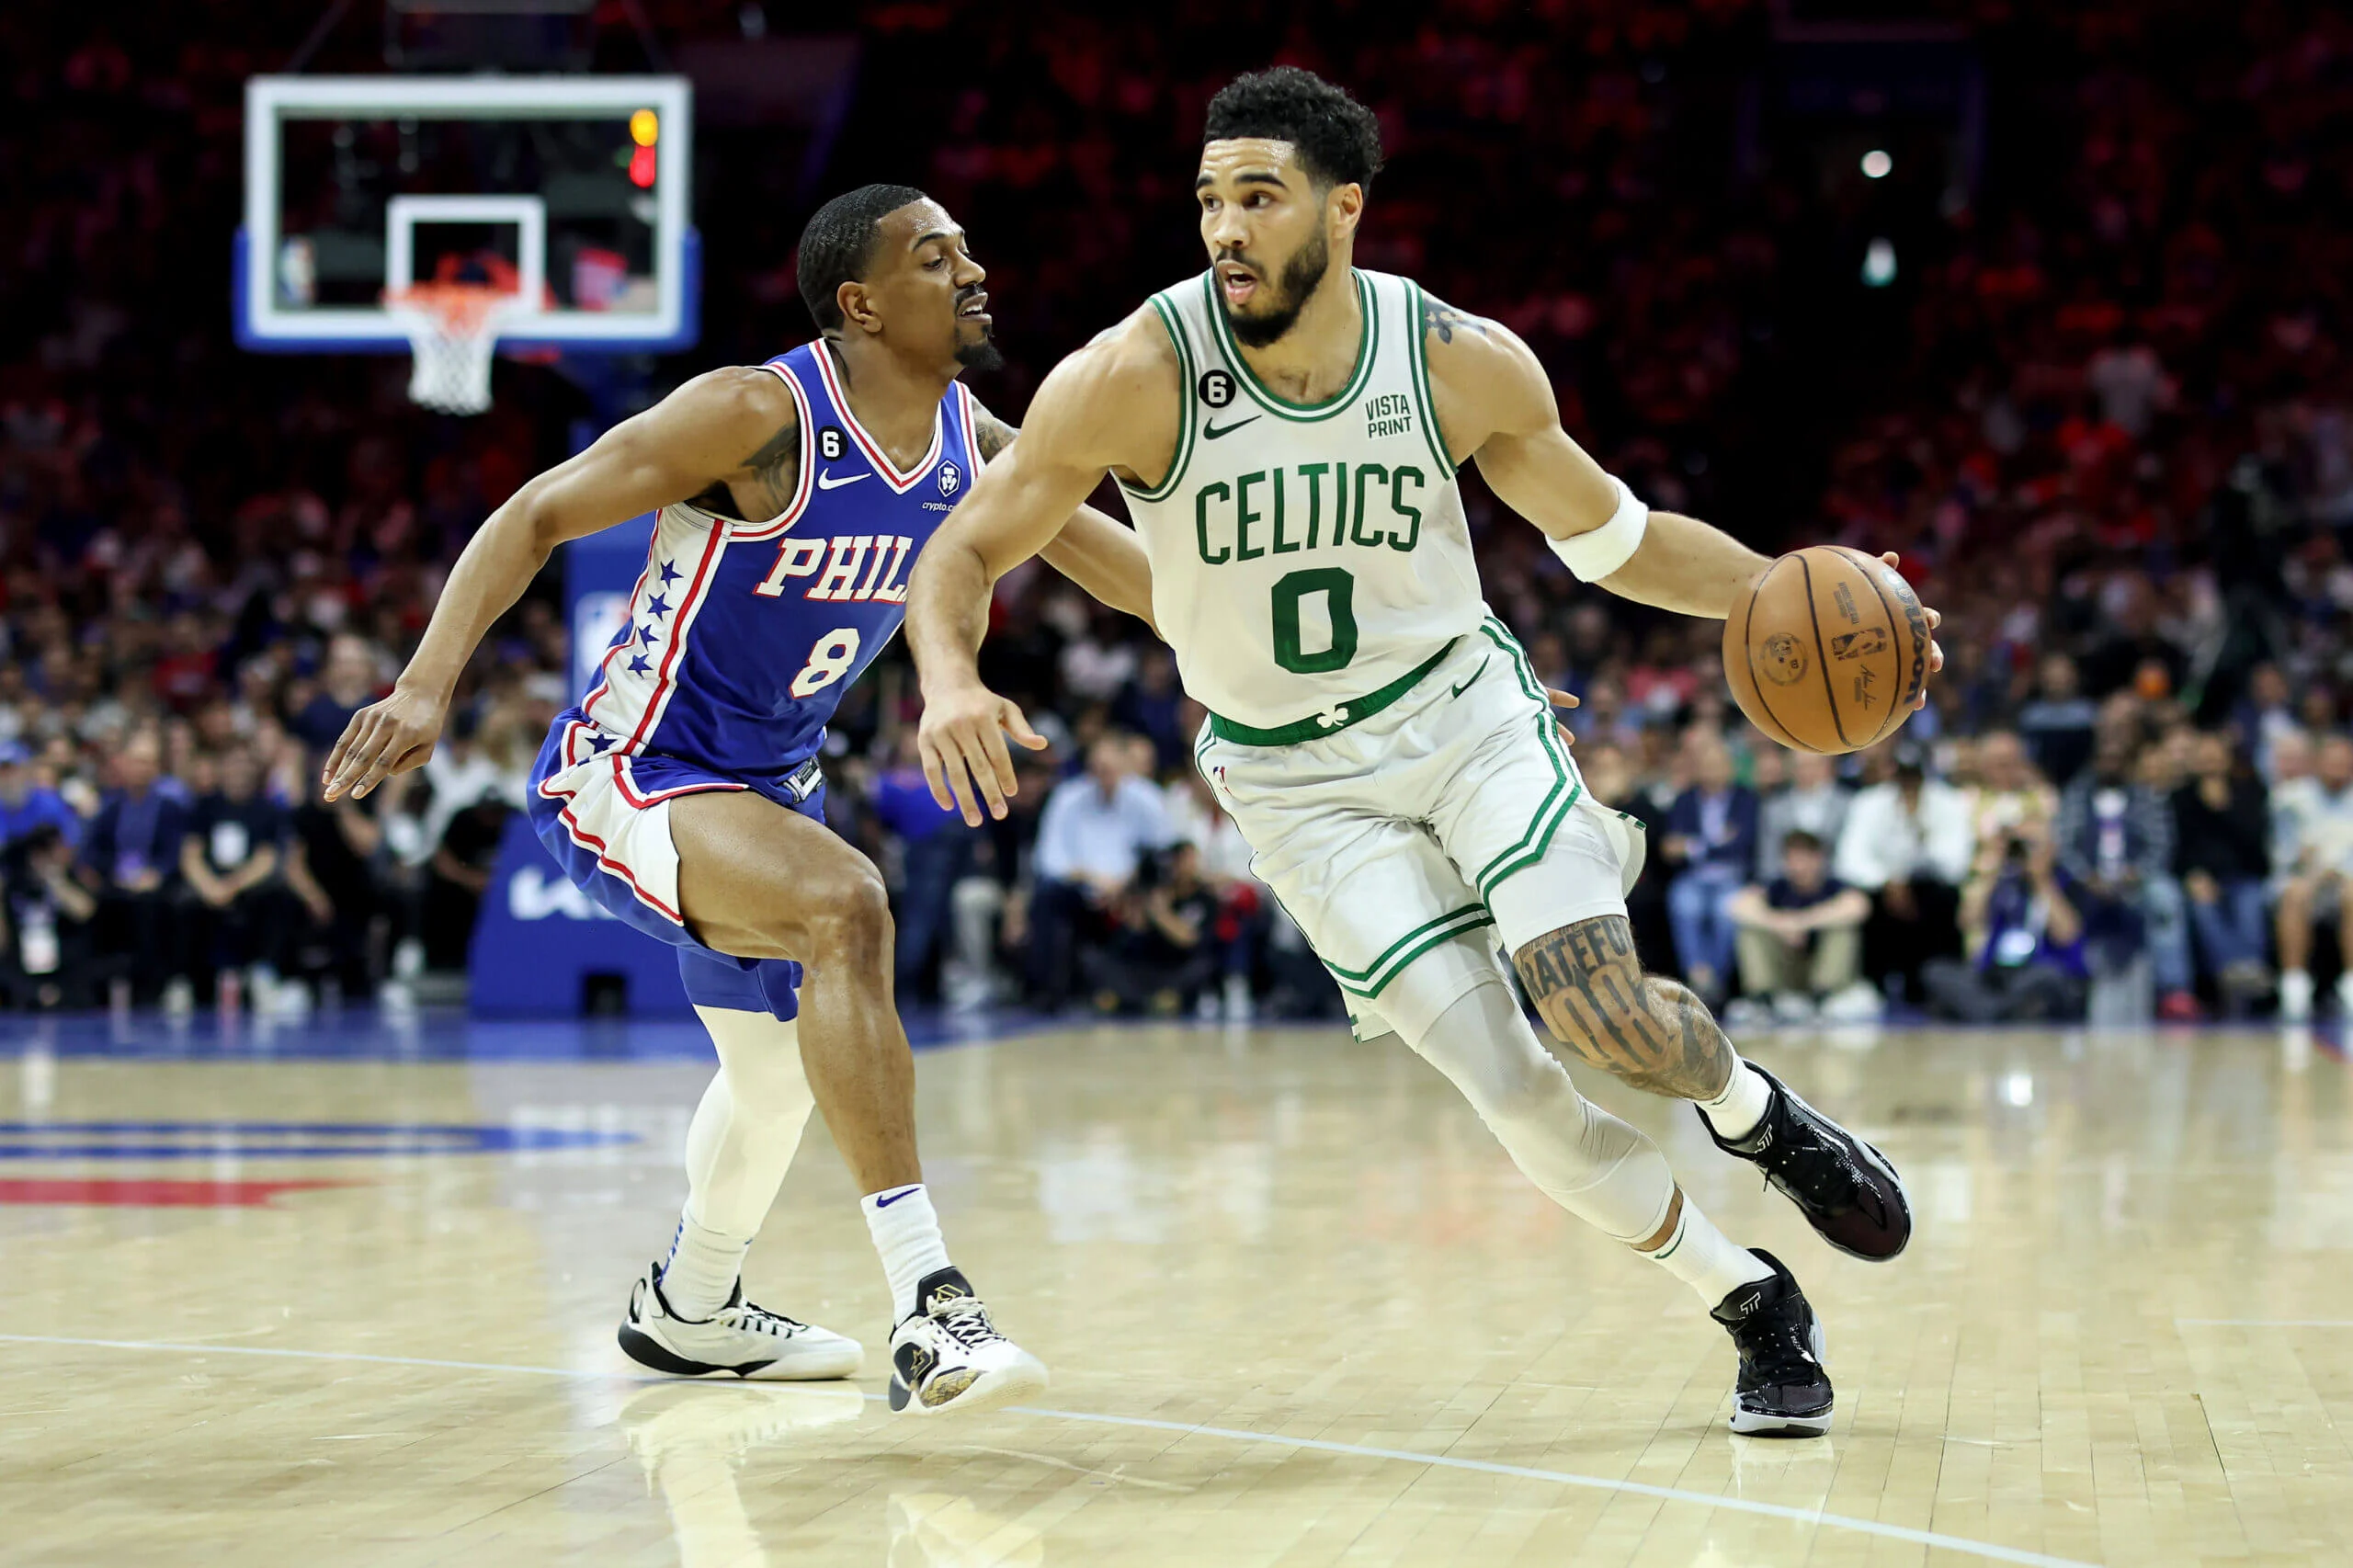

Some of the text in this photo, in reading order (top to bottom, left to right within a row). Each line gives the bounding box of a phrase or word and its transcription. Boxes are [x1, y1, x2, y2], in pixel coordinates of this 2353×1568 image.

[1207, 376, 1227, 404] 6
[1365, 394, 1411, 421] VISTA
[823, 430, 840, 458] 6
[1368, 416, 1412, 438] PRINT
[922, 502, 954, 512] crypto.c
[1196, 462, 1425, 564] CELTICS
[752, 534, 913, 604] PHIL
[1271, 567, 1358, 674] 0
[789, 627, 860, 699] 8
[1519, 917, 1639, 1003] RATEFU
